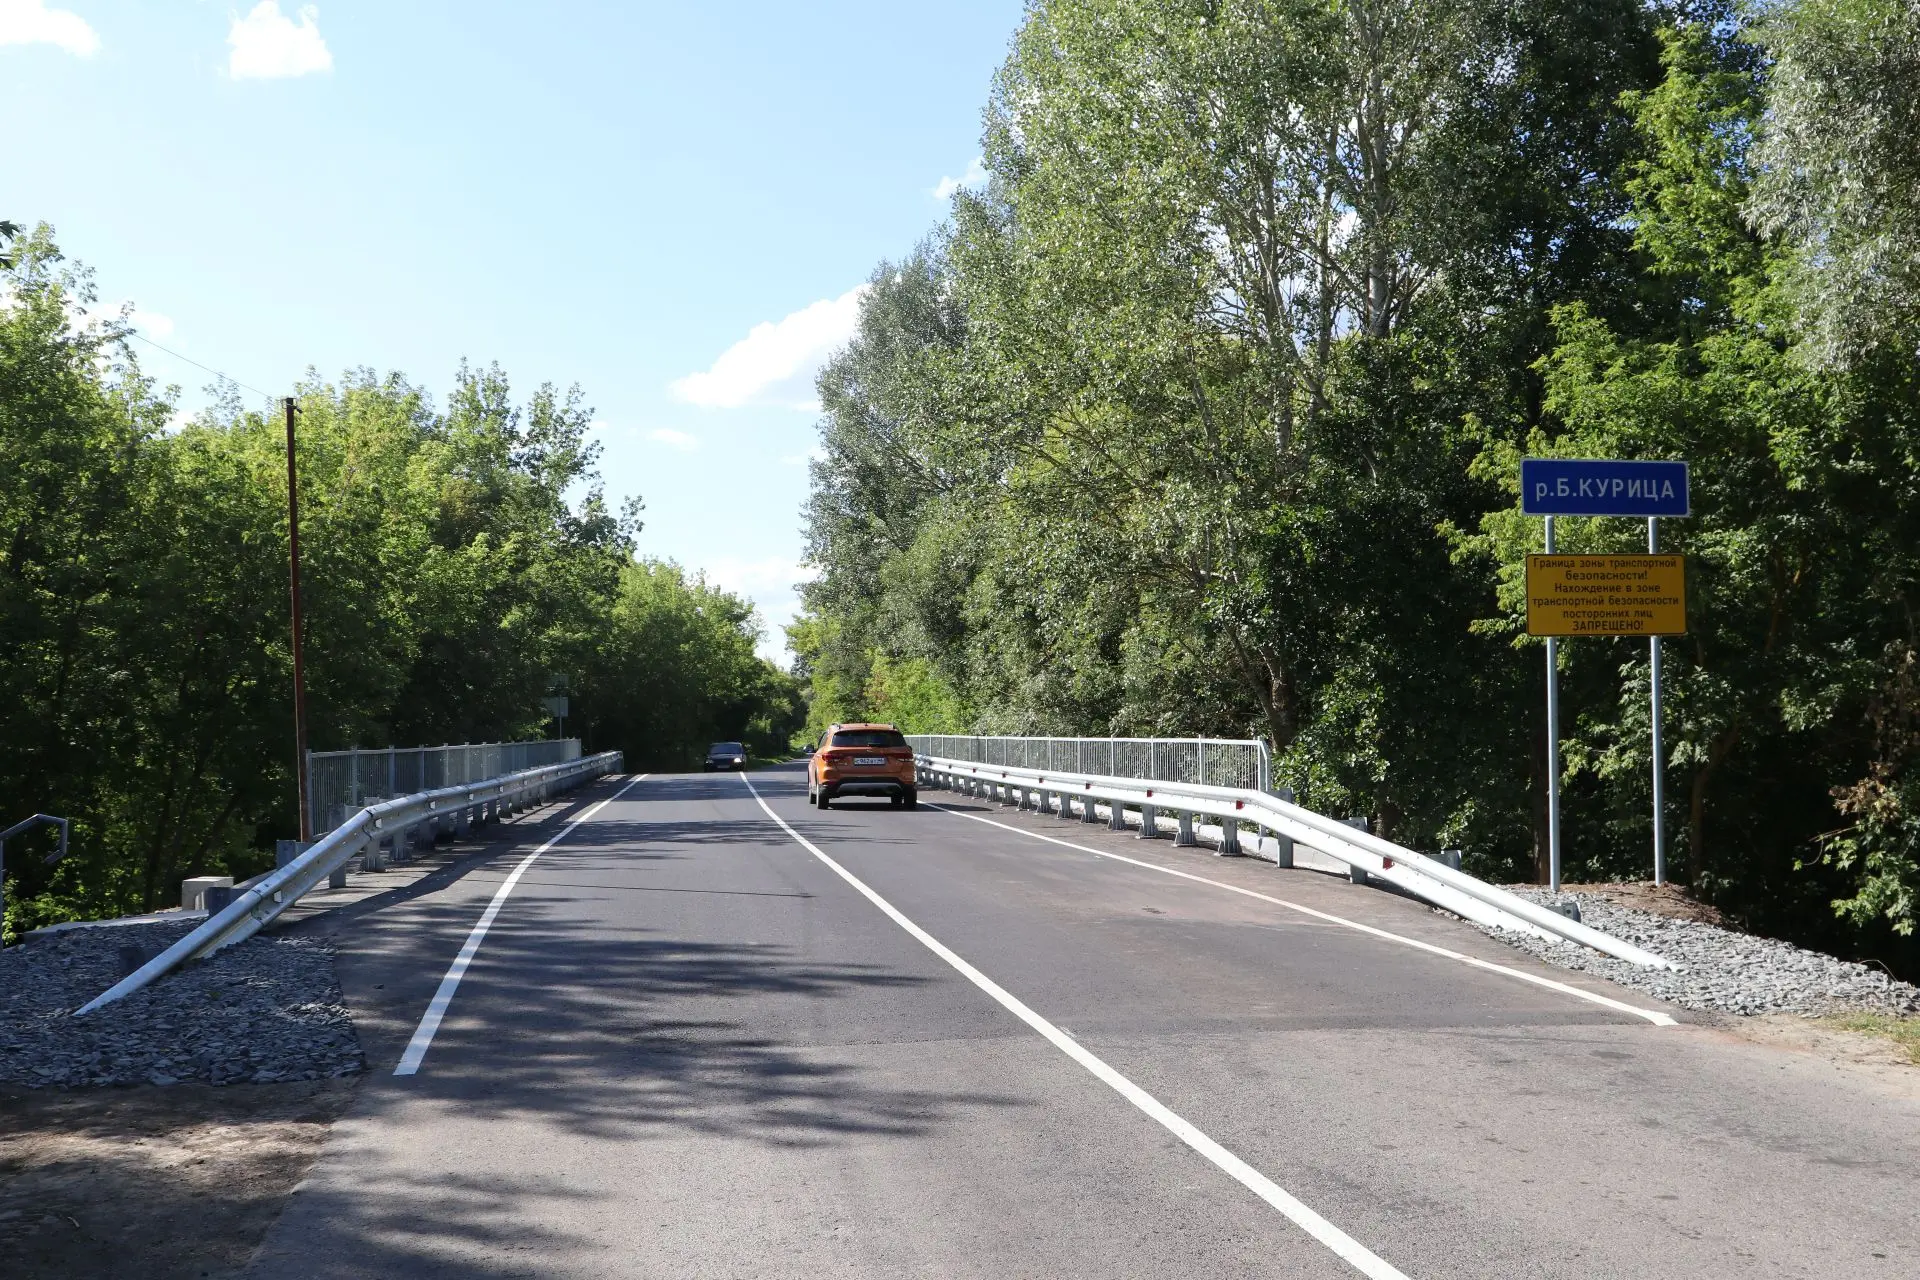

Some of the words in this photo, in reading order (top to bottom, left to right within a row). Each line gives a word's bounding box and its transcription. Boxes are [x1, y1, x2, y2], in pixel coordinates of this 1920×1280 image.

[1535, 478, 1675, 502] р.Б.КУРИЦА
[1533, 557, 1575, 571] Граница
[1579, 559, 1605, 568] зоны
[1610, 557, 1677, 570] транспортной
[1565, 570, 1648, 580] безопасности!
[1554, 582, 1622, 593] Нахождение
[1637, 584, 1661, 593] зоне
[1533, 595, 1604, 607] транспортной
[1608, 595, 1679, 606] безопасности
[1563, 610, 1630, 619] посторонних
[1634, 609, 1653, 619] лиц
[1572, 620, 1644, 632] ЗАПРЕЩЕНО!
